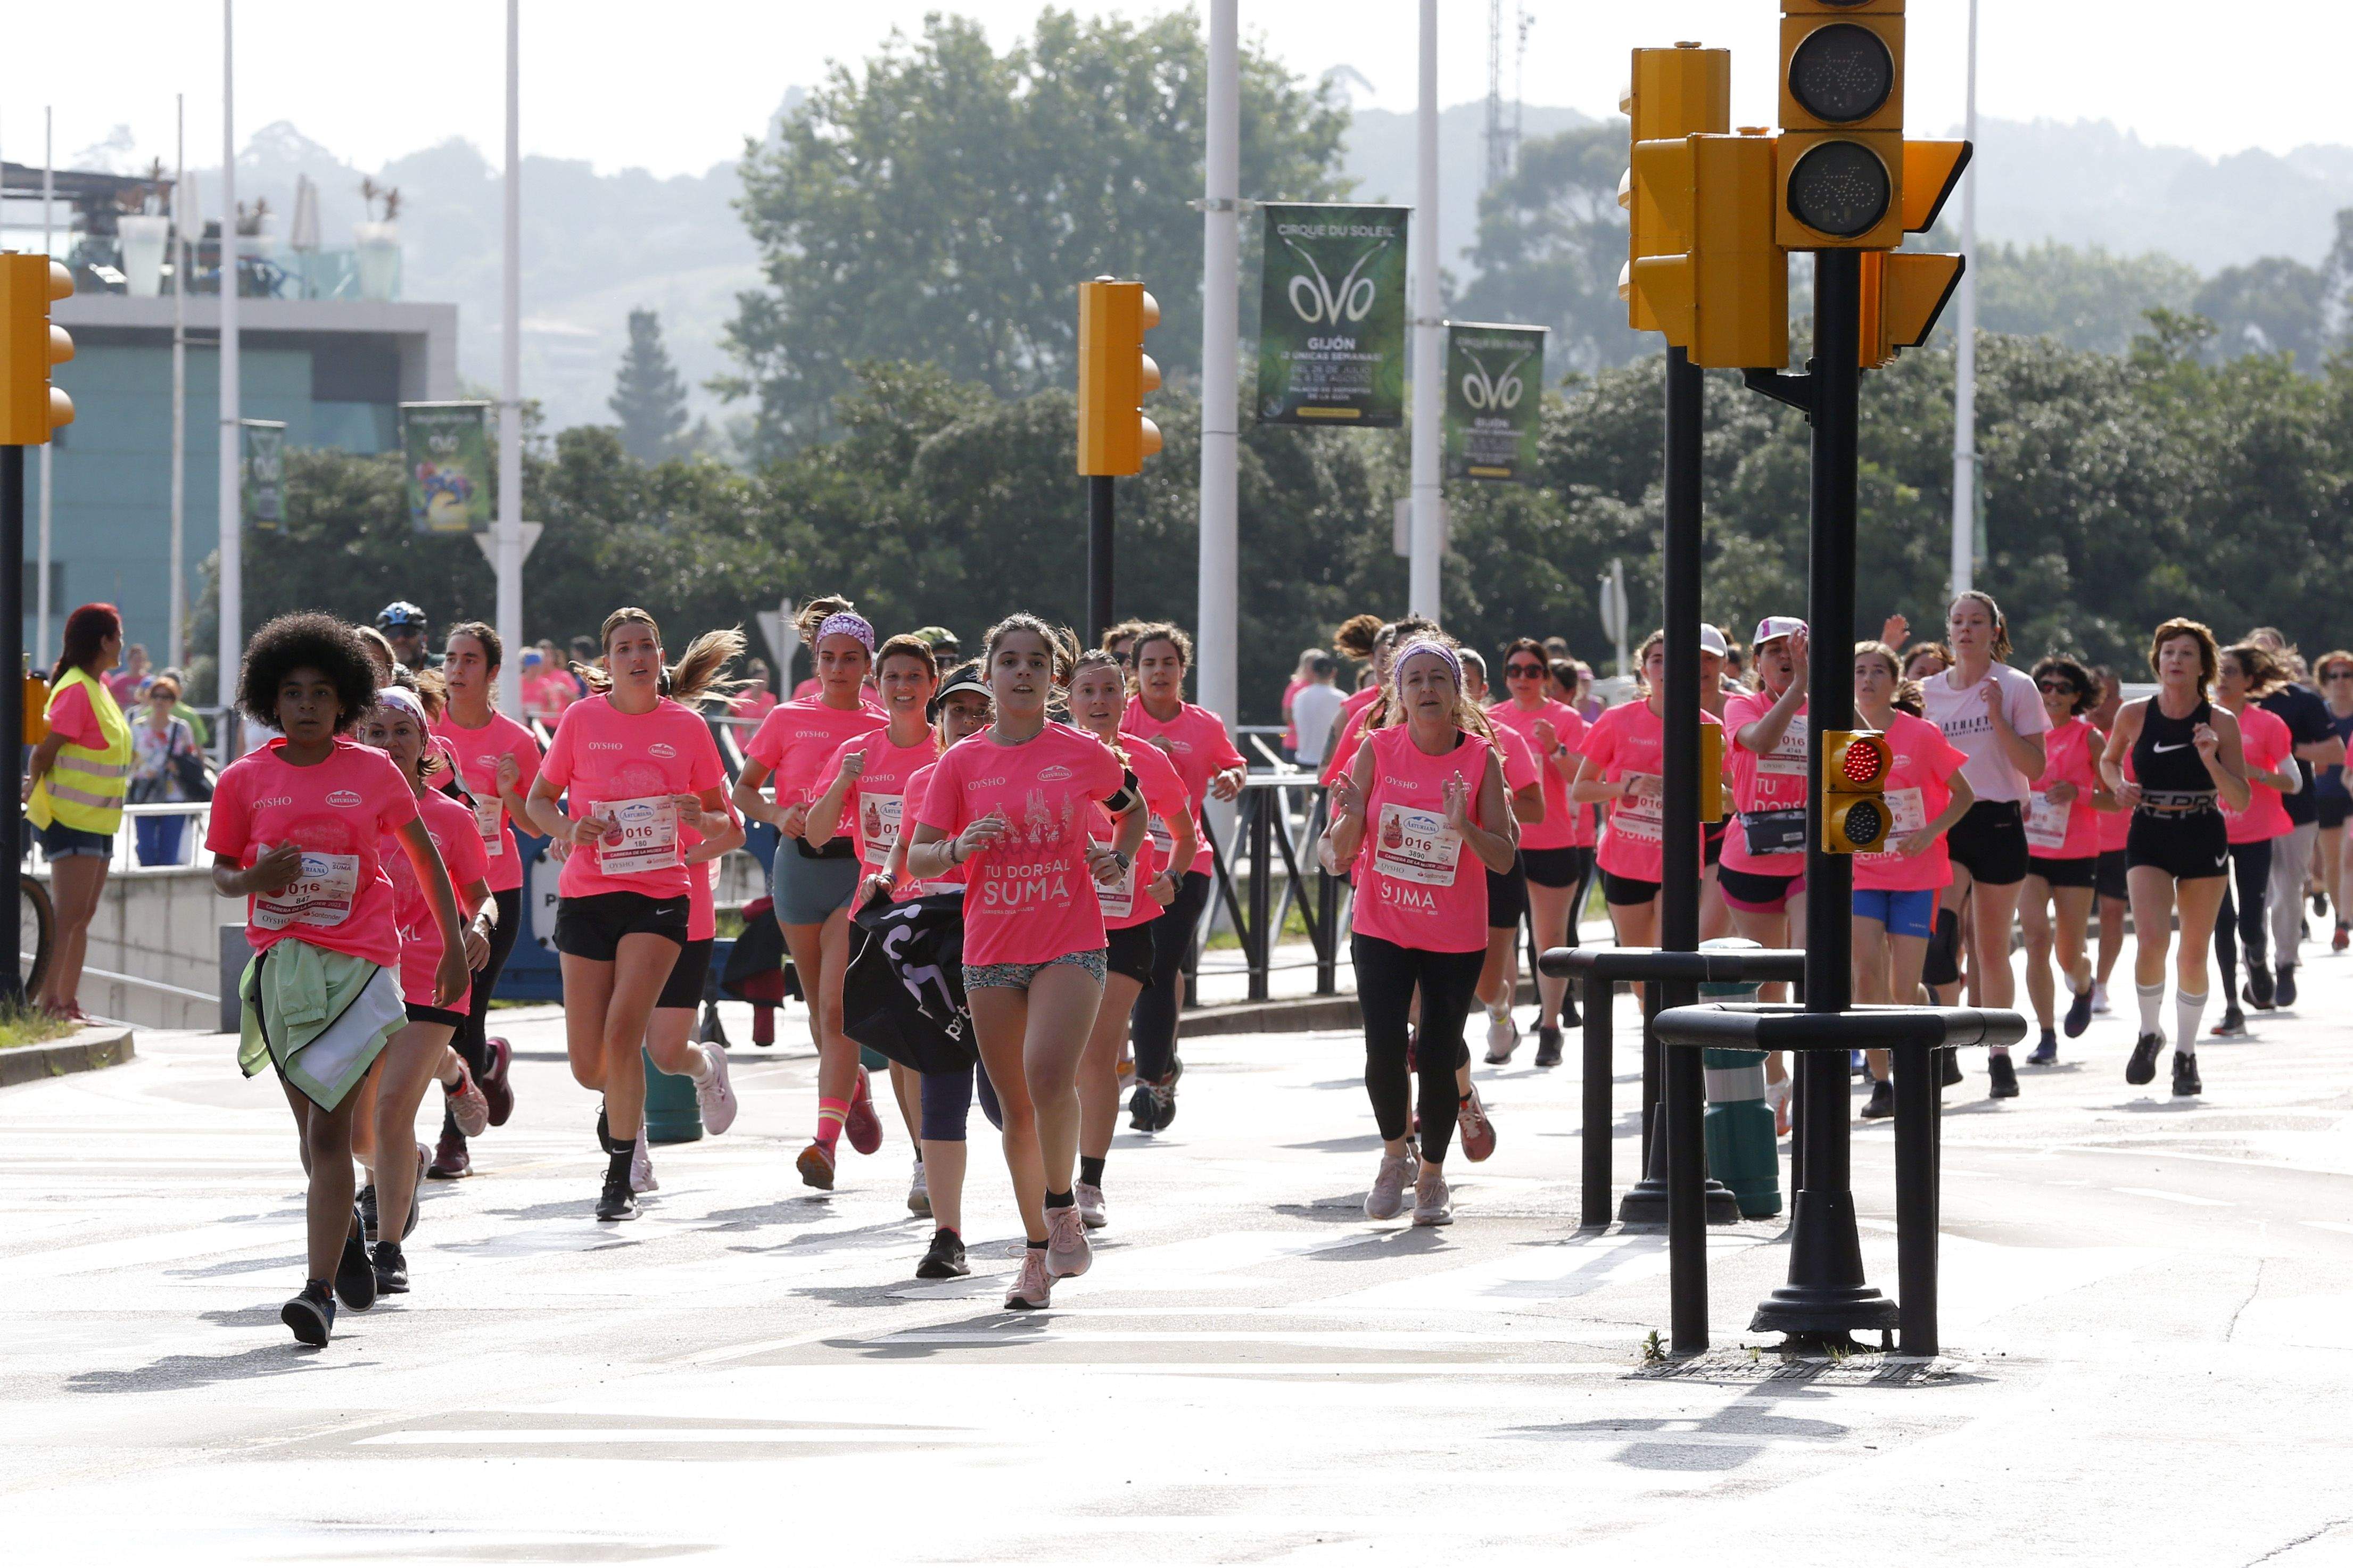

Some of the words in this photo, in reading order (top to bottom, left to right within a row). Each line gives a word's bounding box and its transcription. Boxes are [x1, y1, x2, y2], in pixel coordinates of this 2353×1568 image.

[1277, 224, 1326, 239] CIRQUE
[1328, 225, 1348, 237] DU
[1350, 226, 1395, 238] SOLEIL
[1308, 334, 1356, 350] GIJÓN
[589, 742, 622, 750] OYSHO
[1783, 736, 1805, 746] 016
[862, 774, 895, 783] OYSHO
[968, 777, 1005, 791] OYSHO
[1385, 776, 1418, 790] OYSHO
[1757, 778, 1776, 794] TU
[253, 796, 292, 809] OYSHO
[626, 826, 653, 839] 016
[884, 824, 900, 834] 01
[1407, 820, 1436, 833] ASTURIANA
[1405, 837, 1432, 851] 016
[1384, 853, 1407, 863] CARRERA
[1408, 850, 1425, 860] 3890
[985, 865, 1001, 878] TU
[1007, 859, 1070, 878] DORSAL
[1381, 863, 1405, 874] OYSHO
[288, 883, 321, 894] 016
[984, 875, 1069, 906] SUMA
[296, 895, 310, 905] 847
[266, 905, 291, 913] CARRERA
[311, 911, 342, 920] Santander
